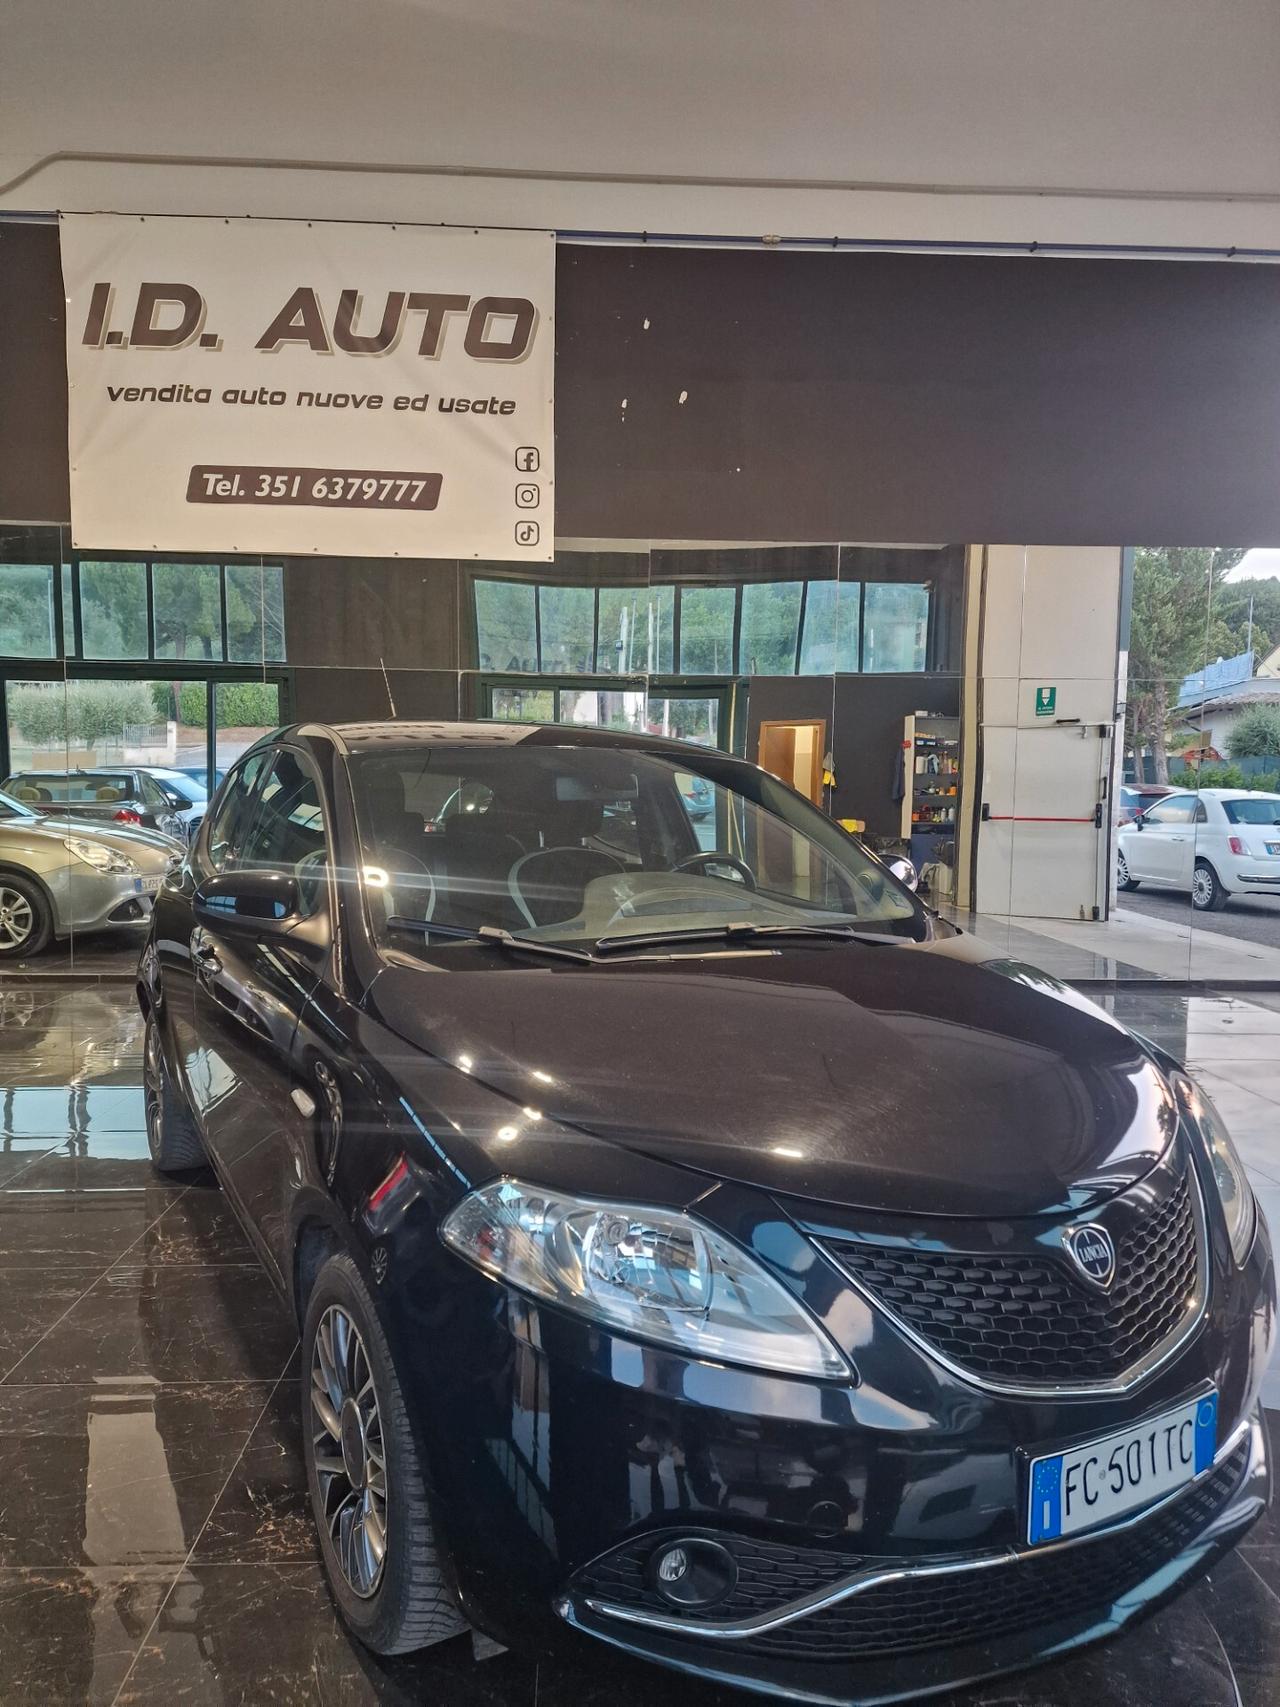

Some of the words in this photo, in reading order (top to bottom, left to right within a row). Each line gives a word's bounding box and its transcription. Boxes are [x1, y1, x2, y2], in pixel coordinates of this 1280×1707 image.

[82, 282, 224, 352] I.D.
[254, 287, 540, 365] AUTO
[107, 384, 212, 403] vendita
[222, 387, 287, 405] auto
[296, 391, 384, 410] nuove
[393, 394, 429, 412] ed
[438, 396, 517, 415] usate
[203, 473, 246, 496] Tel.
[255, 474, 301, 498] 351
[311, 477, 427, 502] 6379777
